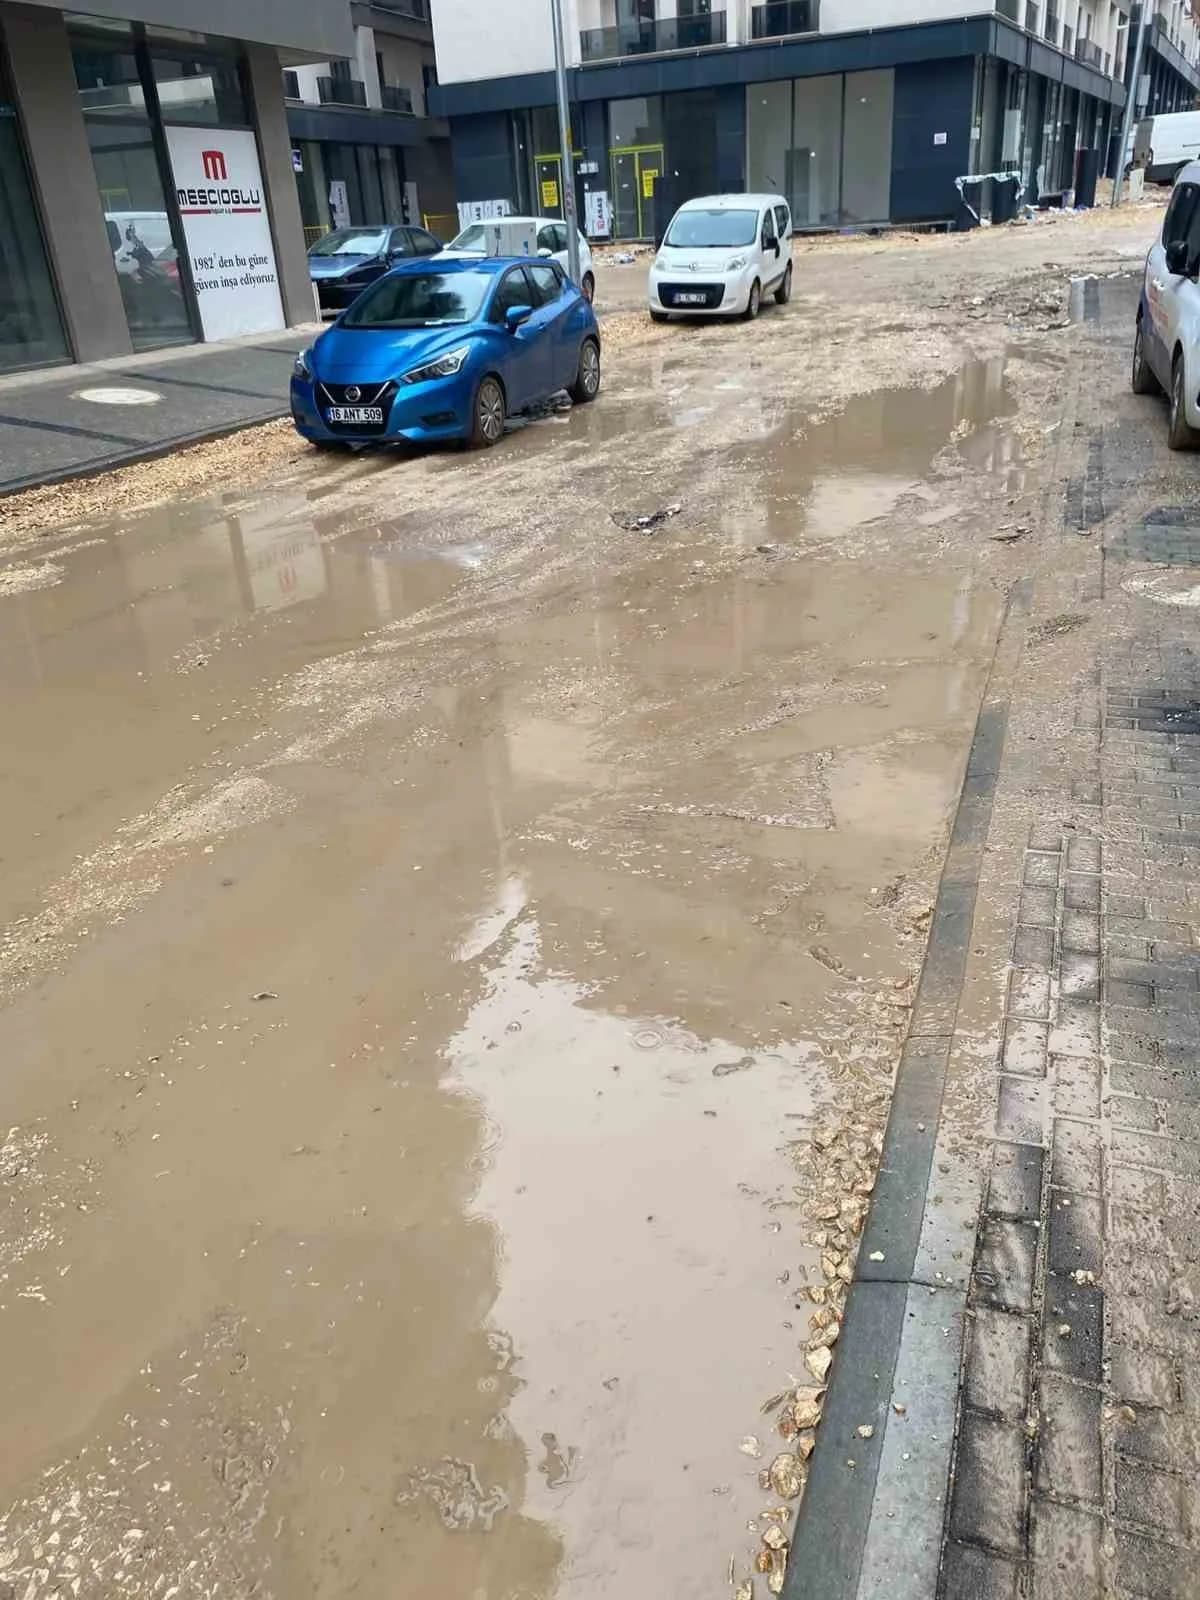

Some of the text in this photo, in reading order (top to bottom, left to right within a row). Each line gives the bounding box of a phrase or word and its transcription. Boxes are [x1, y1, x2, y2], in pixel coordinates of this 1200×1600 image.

[219, 256, 234, 269] den
[235, 254, 247, 267] bu
[248, 254, 268, 270] güne
[194, 278, 219, 296] güven
[220, 276, 238, 290] inşa
[331, 408, 381, 420] 16 ANT 509
